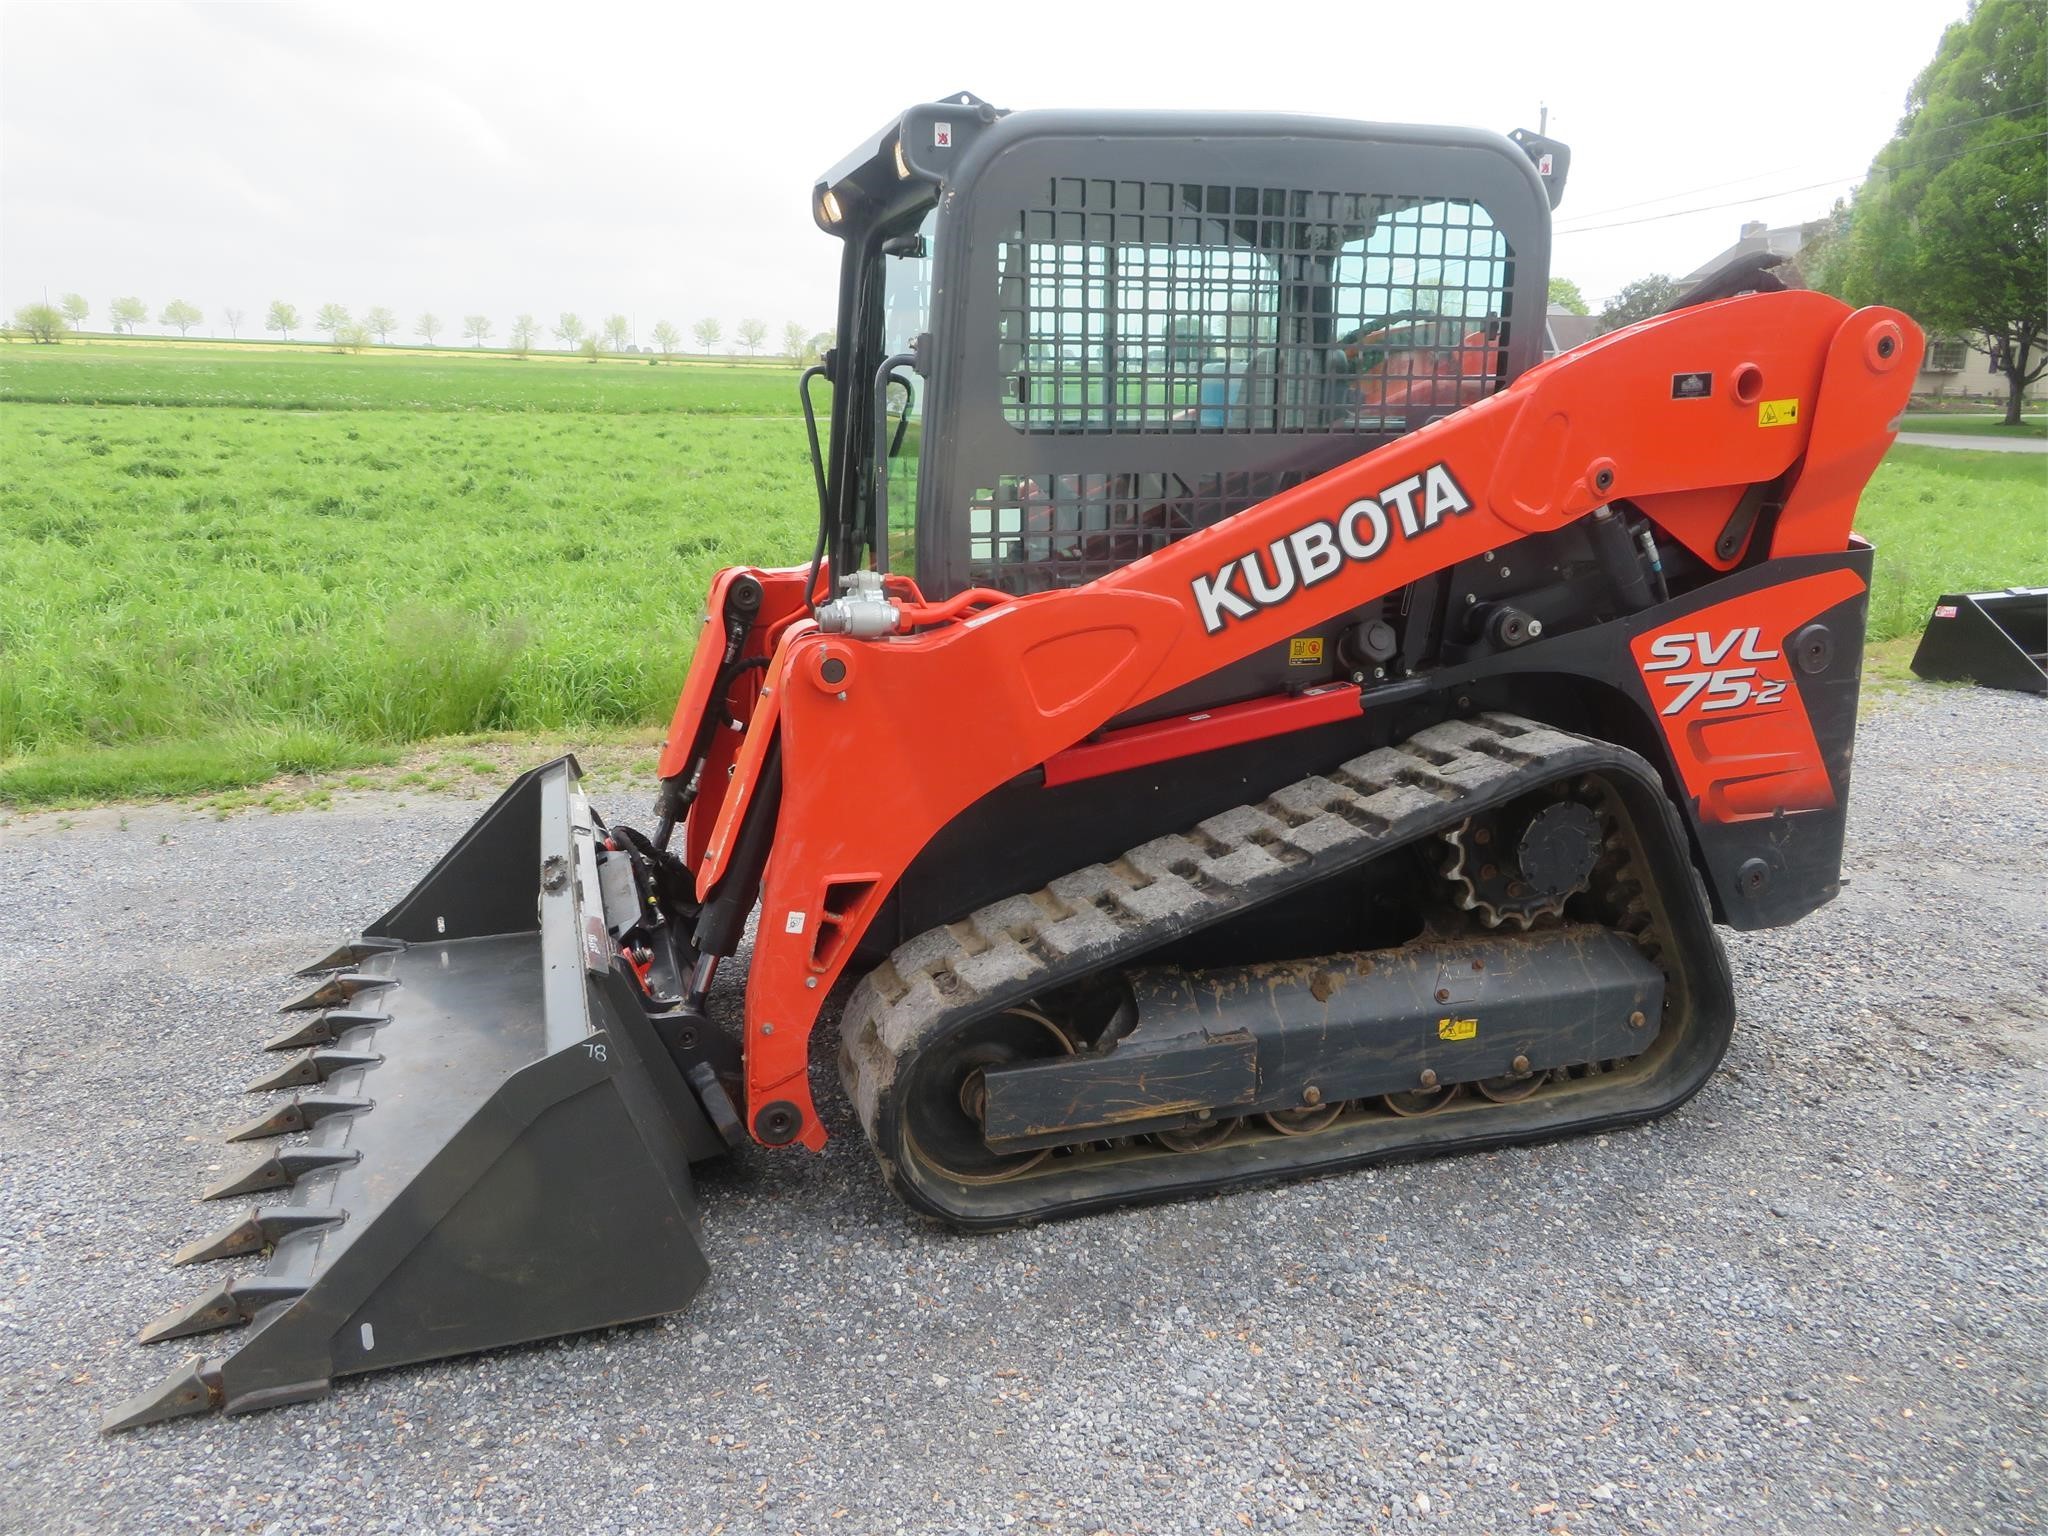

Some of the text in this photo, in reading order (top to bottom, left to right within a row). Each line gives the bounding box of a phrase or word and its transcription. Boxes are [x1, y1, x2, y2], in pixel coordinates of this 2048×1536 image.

[1191, 463, 1470, 634] KUBOTA
[1643, 626, 1779, 671] SVL
[582, 1043, 607, 1062] 78
